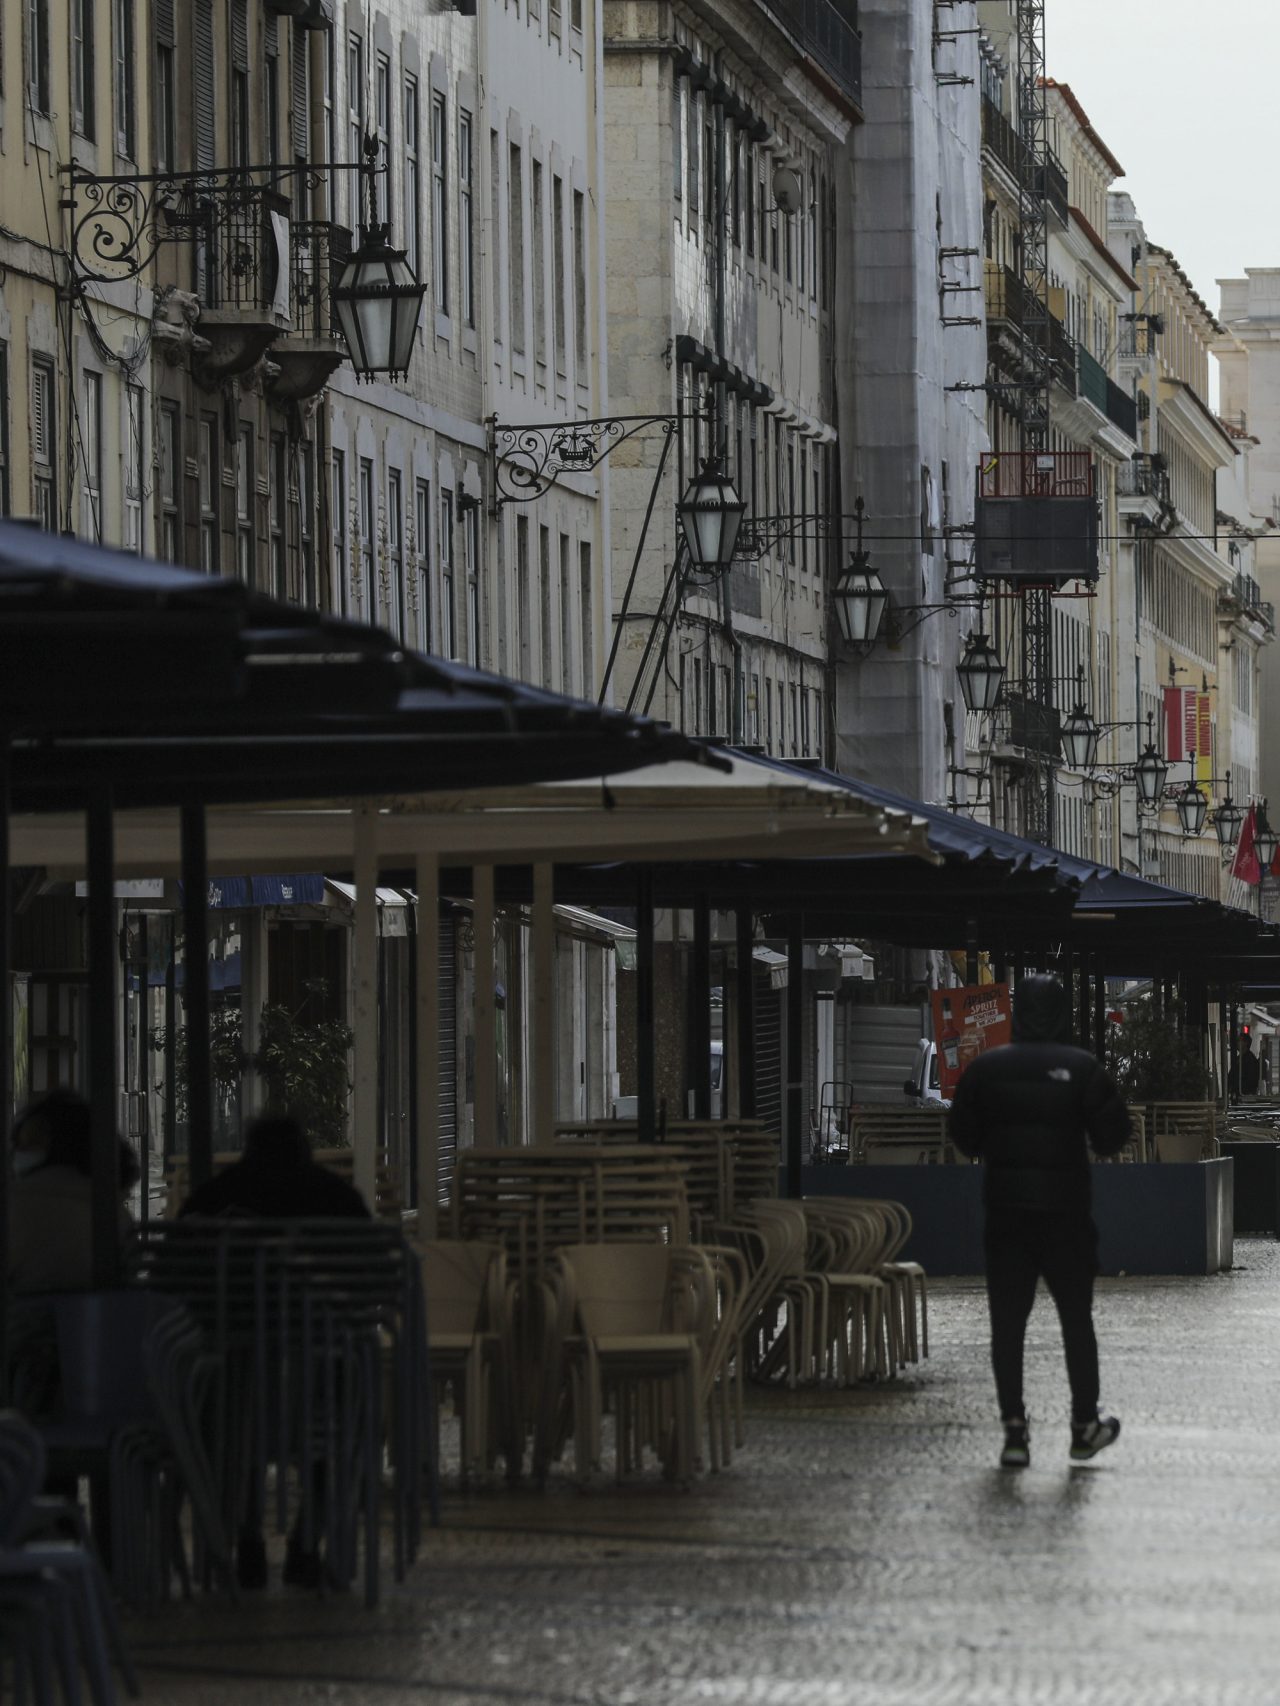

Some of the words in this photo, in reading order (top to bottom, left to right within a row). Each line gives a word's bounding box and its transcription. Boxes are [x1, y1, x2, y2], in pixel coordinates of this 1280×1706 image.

[1185, 690, 1197, 752] MILLENNIUM
[1198, 697, 1211, 757] MILLENNIUM
[970, 999, 998, 1014] SPRITZ
